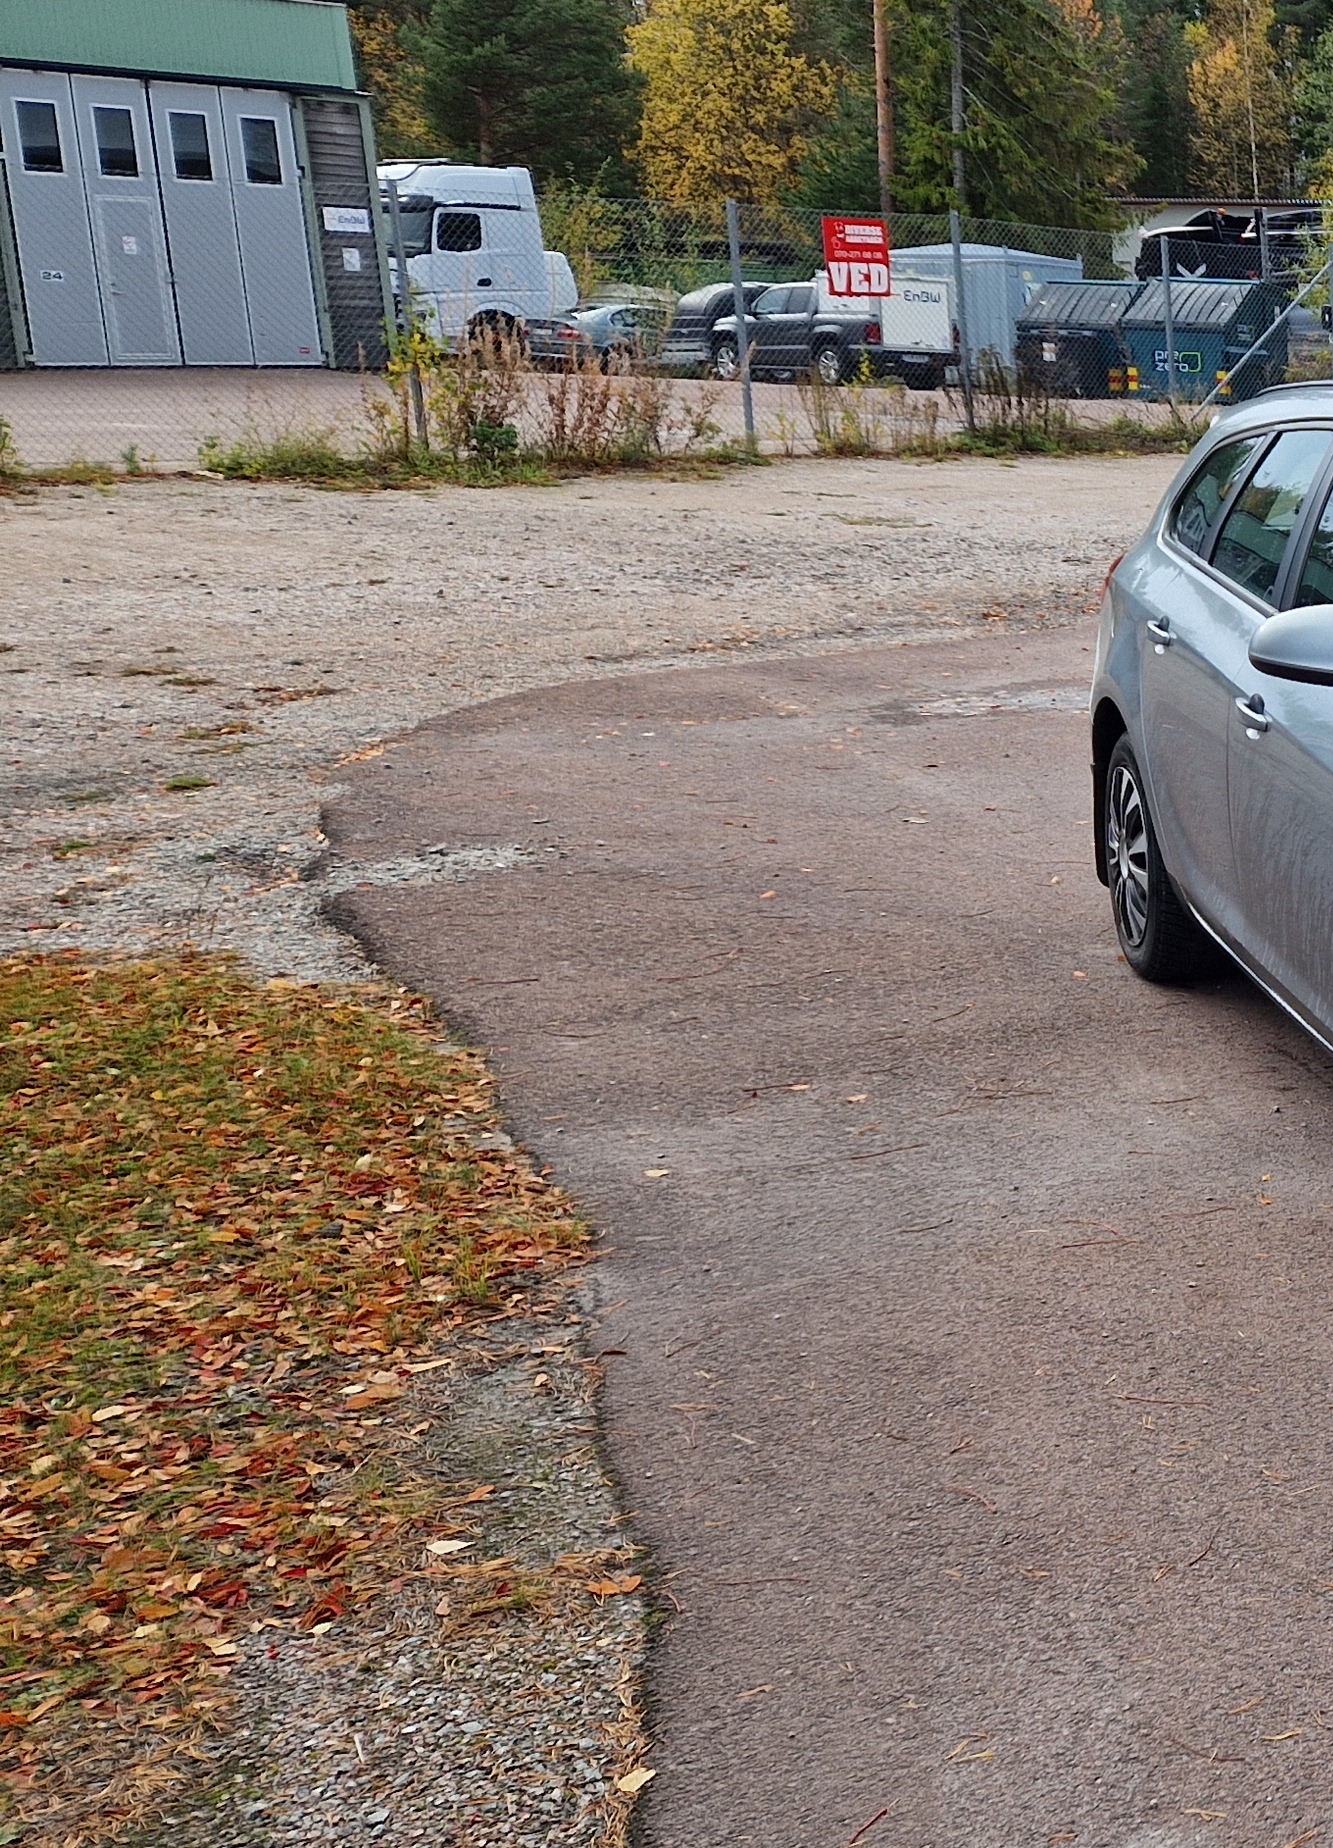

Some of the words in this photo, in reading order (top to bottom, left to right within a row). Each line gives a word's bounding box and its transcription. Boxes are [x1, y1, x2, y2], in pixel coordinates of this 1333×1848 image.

[42, 271, 63, 280] 24
[828, 261, 889, 293] VED
[904, 290, 941, 303] EnBW
